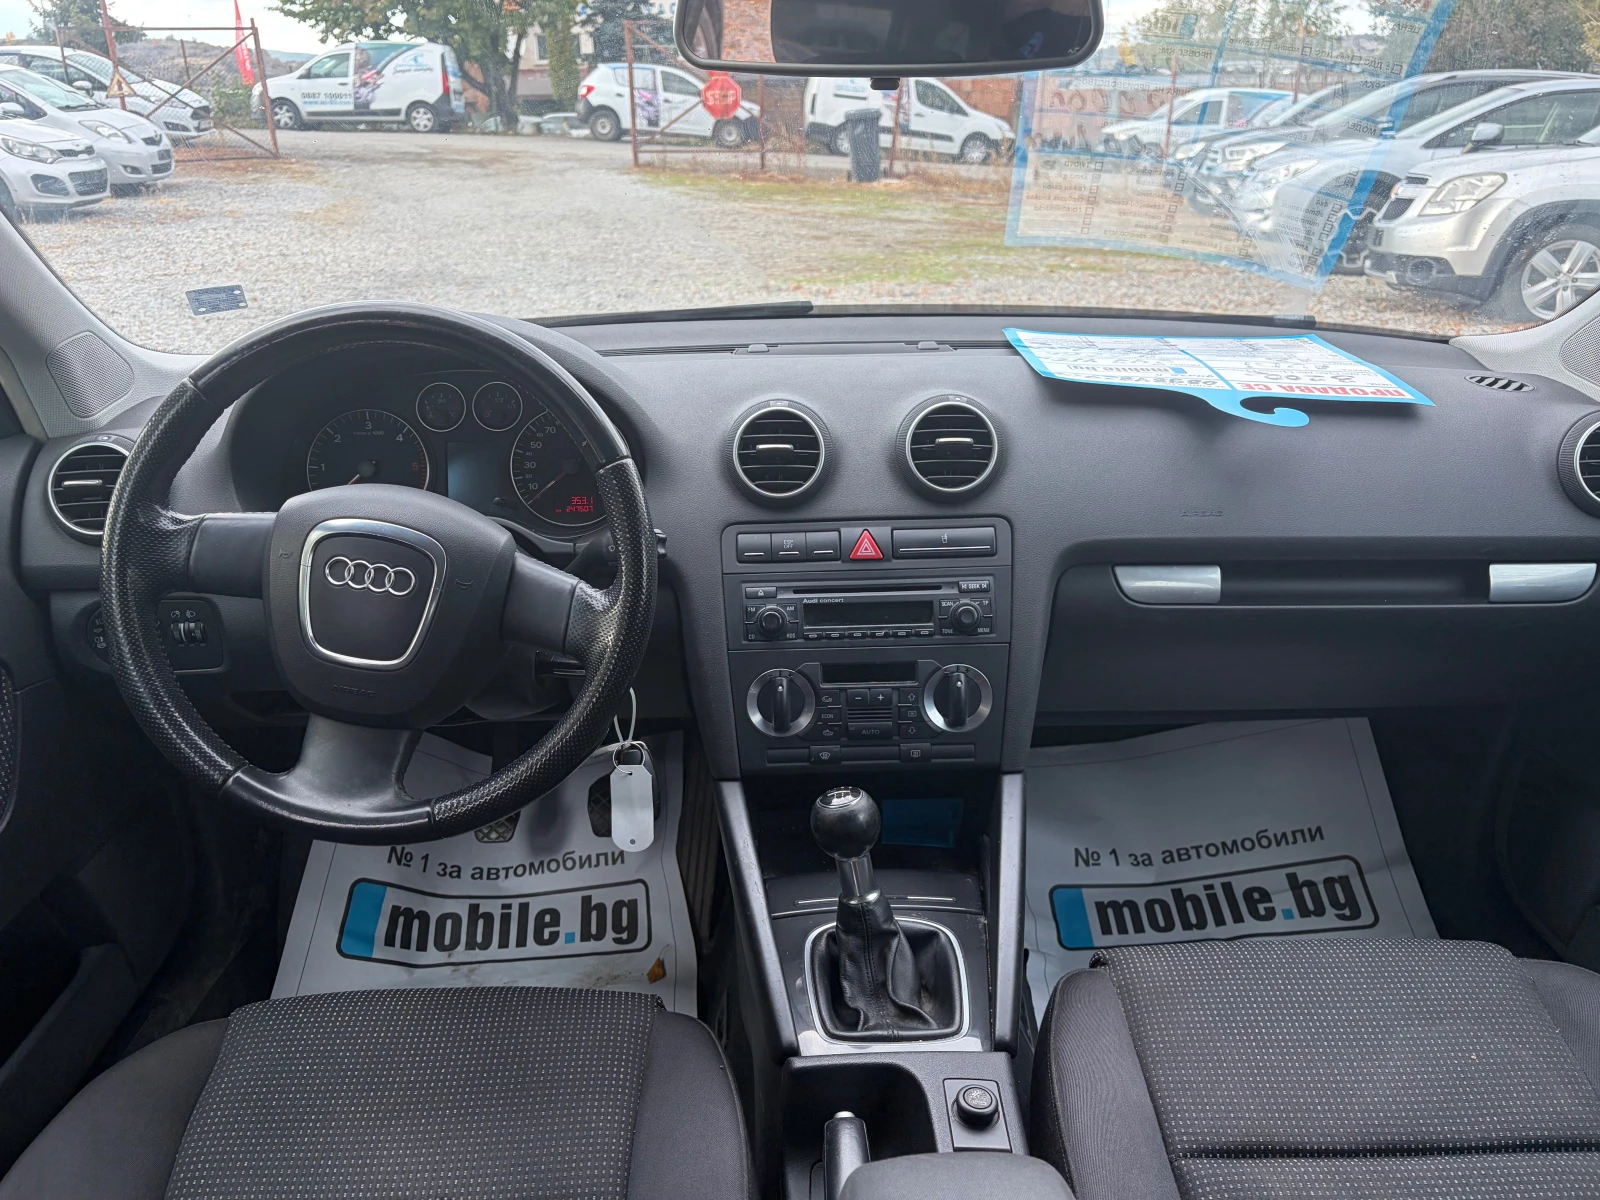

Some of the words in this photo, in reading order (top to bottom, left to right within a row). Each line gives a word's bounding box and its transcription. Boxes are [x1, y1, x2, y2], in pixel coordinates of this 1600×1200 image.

[705, 90, 737, 105] STOP
[1237, 382, 1272, 392] СЕ
[1279, 384, 1406, 397] ПРОДАВА
[365, 421, 372, 430] 3
[545, 426, 556, 434] 70
[334, 434, 342, 443] 2
[396, 434, 403, 442] 4
[530, 441, 542, 449] 50
[320, 463, 325, 471] 1
[412, 462, 419, 471] 5
[524, 461, 536, 469] 30
[528, 482, 538, 490] 10
[571, 496, 594, 505] 353.1
[1073, 847, 1102, 867] №
[1109, 848, 1121, 866] 1
[1129, 850, 1154, 867] за
[1162, 825, 1326, 865] автомобили
[387, 845, 414, 868] №
[420, 853, 430, 873] 1
[436, 861, 461, 880] за
[471, 850, 627, 880] автомобили
[1094, 872, 1363, 936] mobile.bg
[384, 894, 639, 953] mobile.bg
